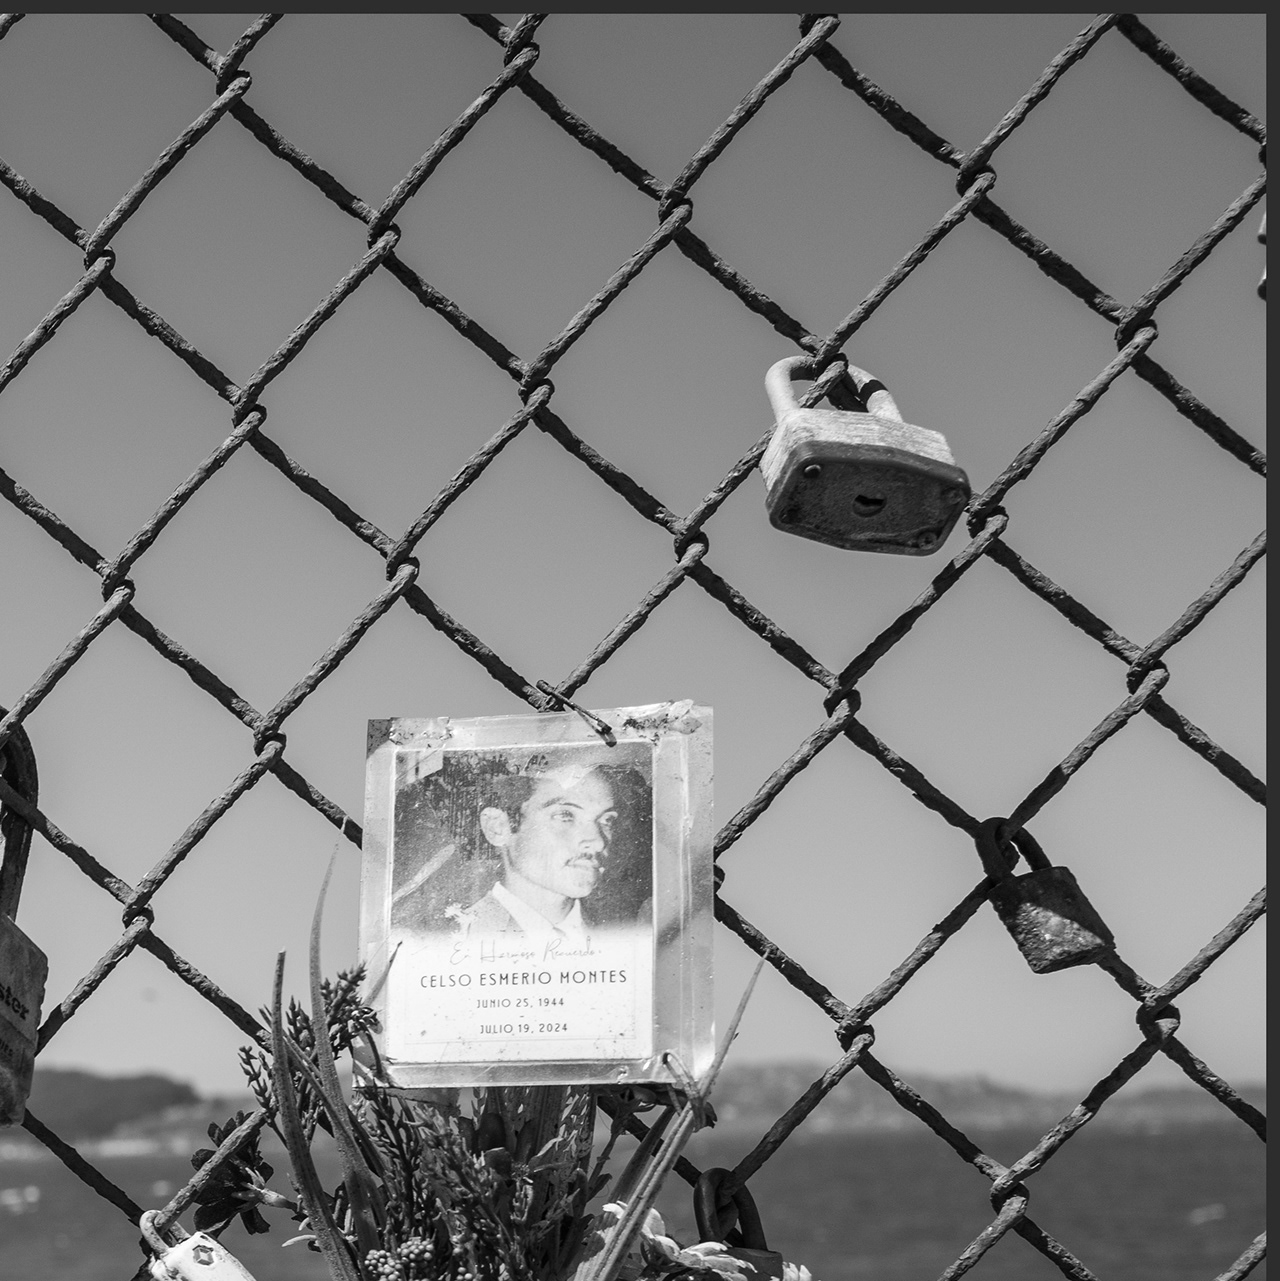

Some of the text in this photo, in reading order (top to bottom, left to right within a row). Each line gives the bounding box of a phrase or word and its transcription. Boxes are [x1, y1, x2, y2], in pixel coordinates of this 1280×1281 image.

[420, 969, 628, 989] CELSO ESMERIO MONTES
[476, 997, 565, 1009] JUNIO 25, 1944
[480, 1022, 568, 1034] JULIO 19, 2024
